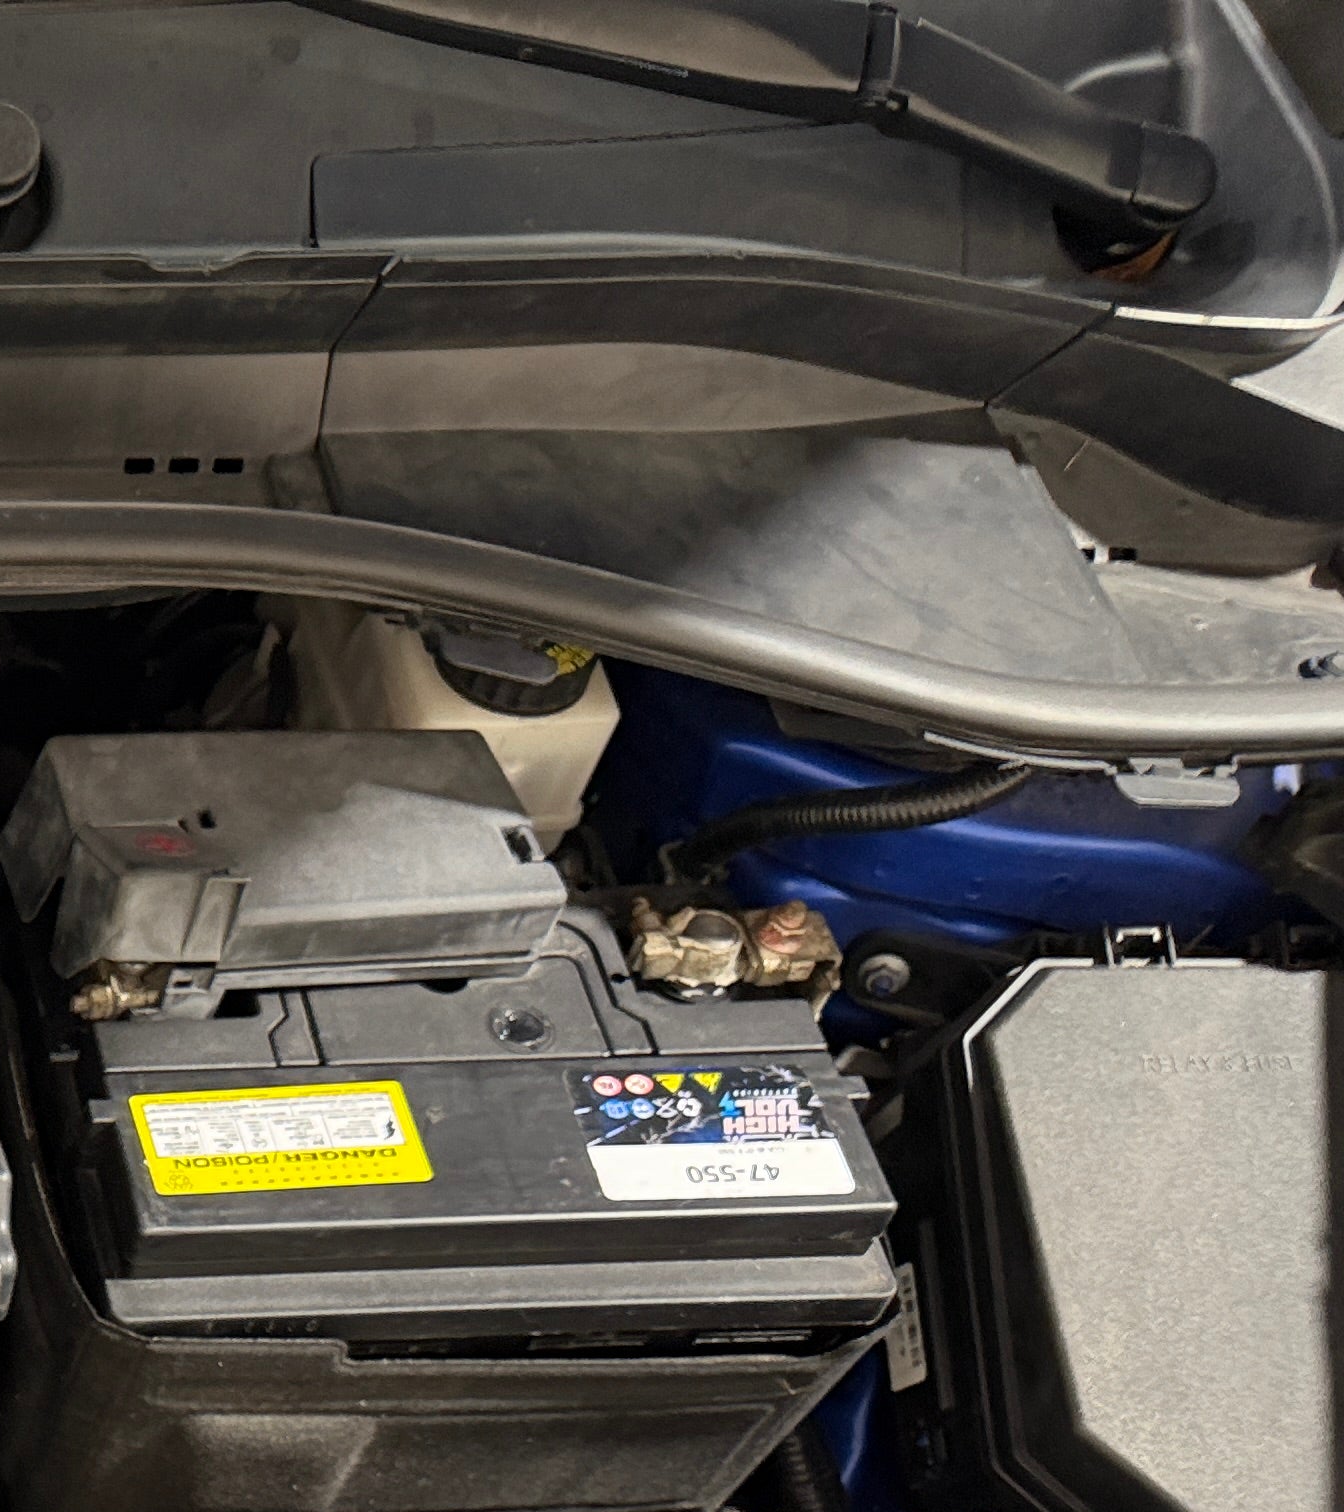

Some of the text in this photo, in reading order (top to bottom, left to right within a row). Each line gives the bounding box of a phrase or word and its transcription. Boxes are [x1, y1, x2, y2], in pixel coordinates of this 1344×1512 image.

[718, 1092, 798, 1116] VOLT
[722, 1116, 800, 1135] HIGH
[685, 1163, 782, 1185] 47-550
